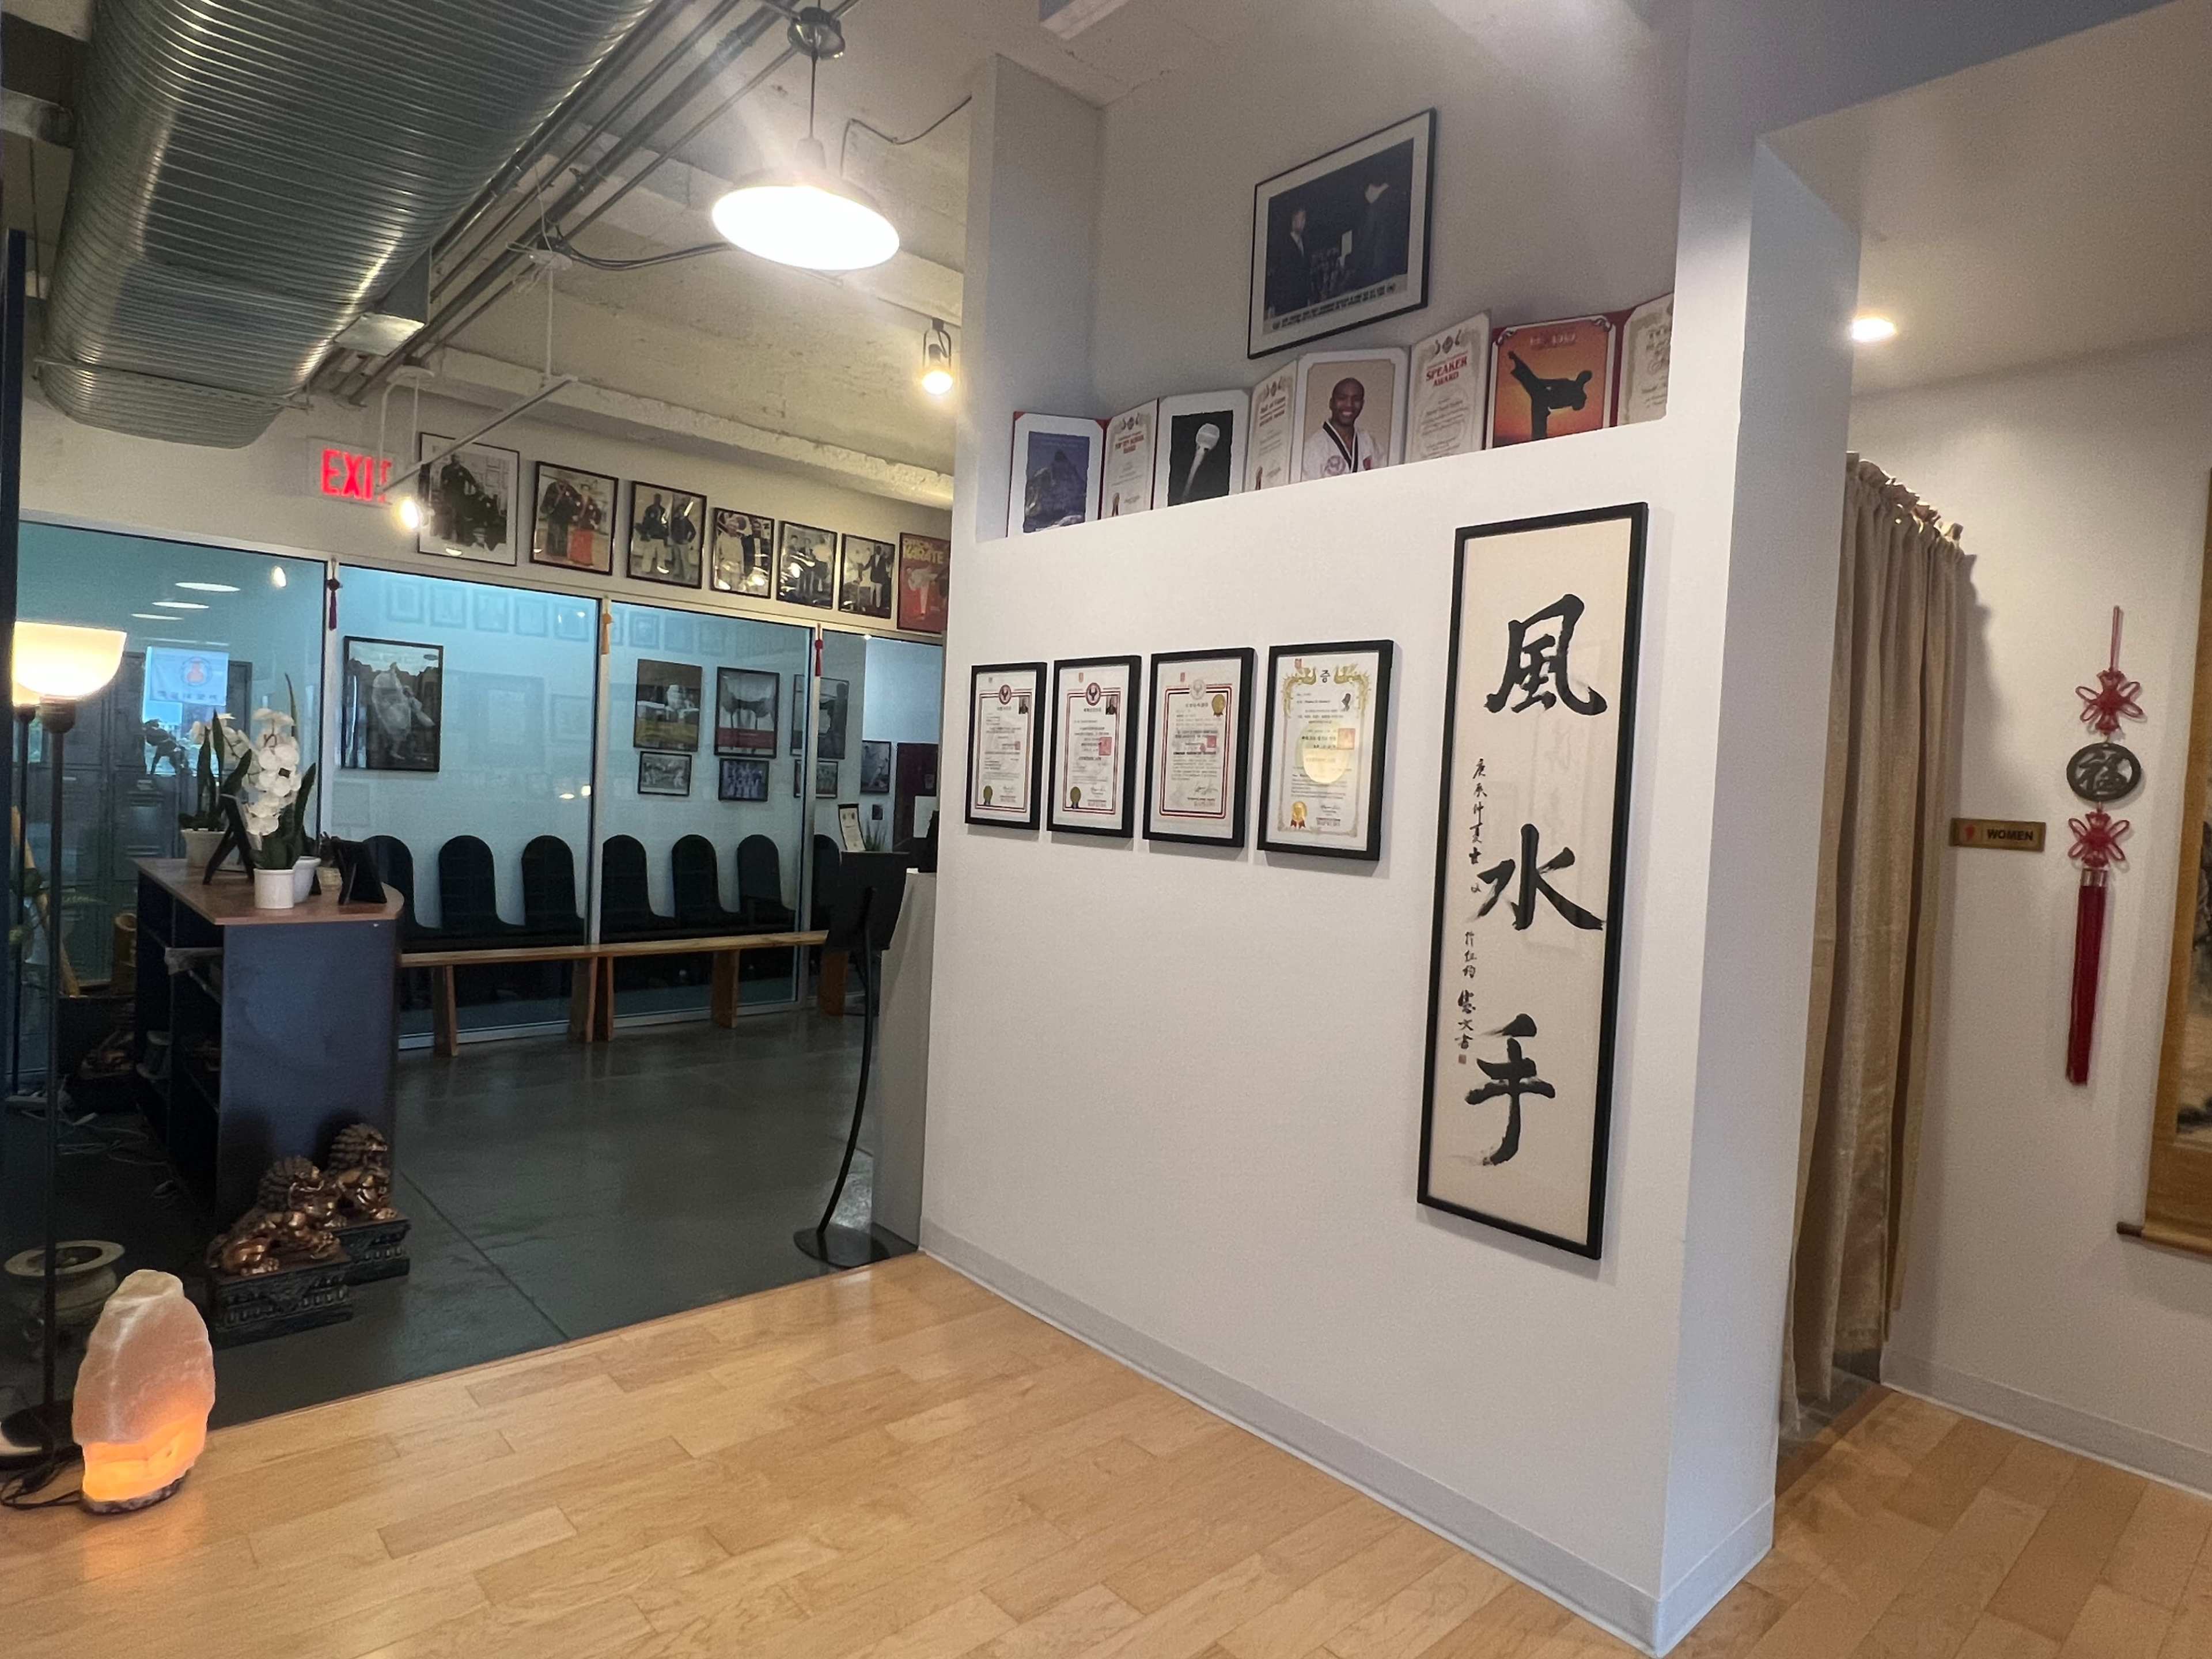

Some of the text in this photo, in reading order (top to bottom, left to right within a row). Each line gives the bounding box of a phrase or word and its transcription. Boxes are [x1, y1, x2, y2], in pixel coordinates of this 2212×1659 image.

[1426, 355, 1468, 382] SPEAKER
[1433, 371, 1460, 387] AWARD
[903, 544, 945, 565] KARATE
[1987, 828, 2033, 841] WOMEN
